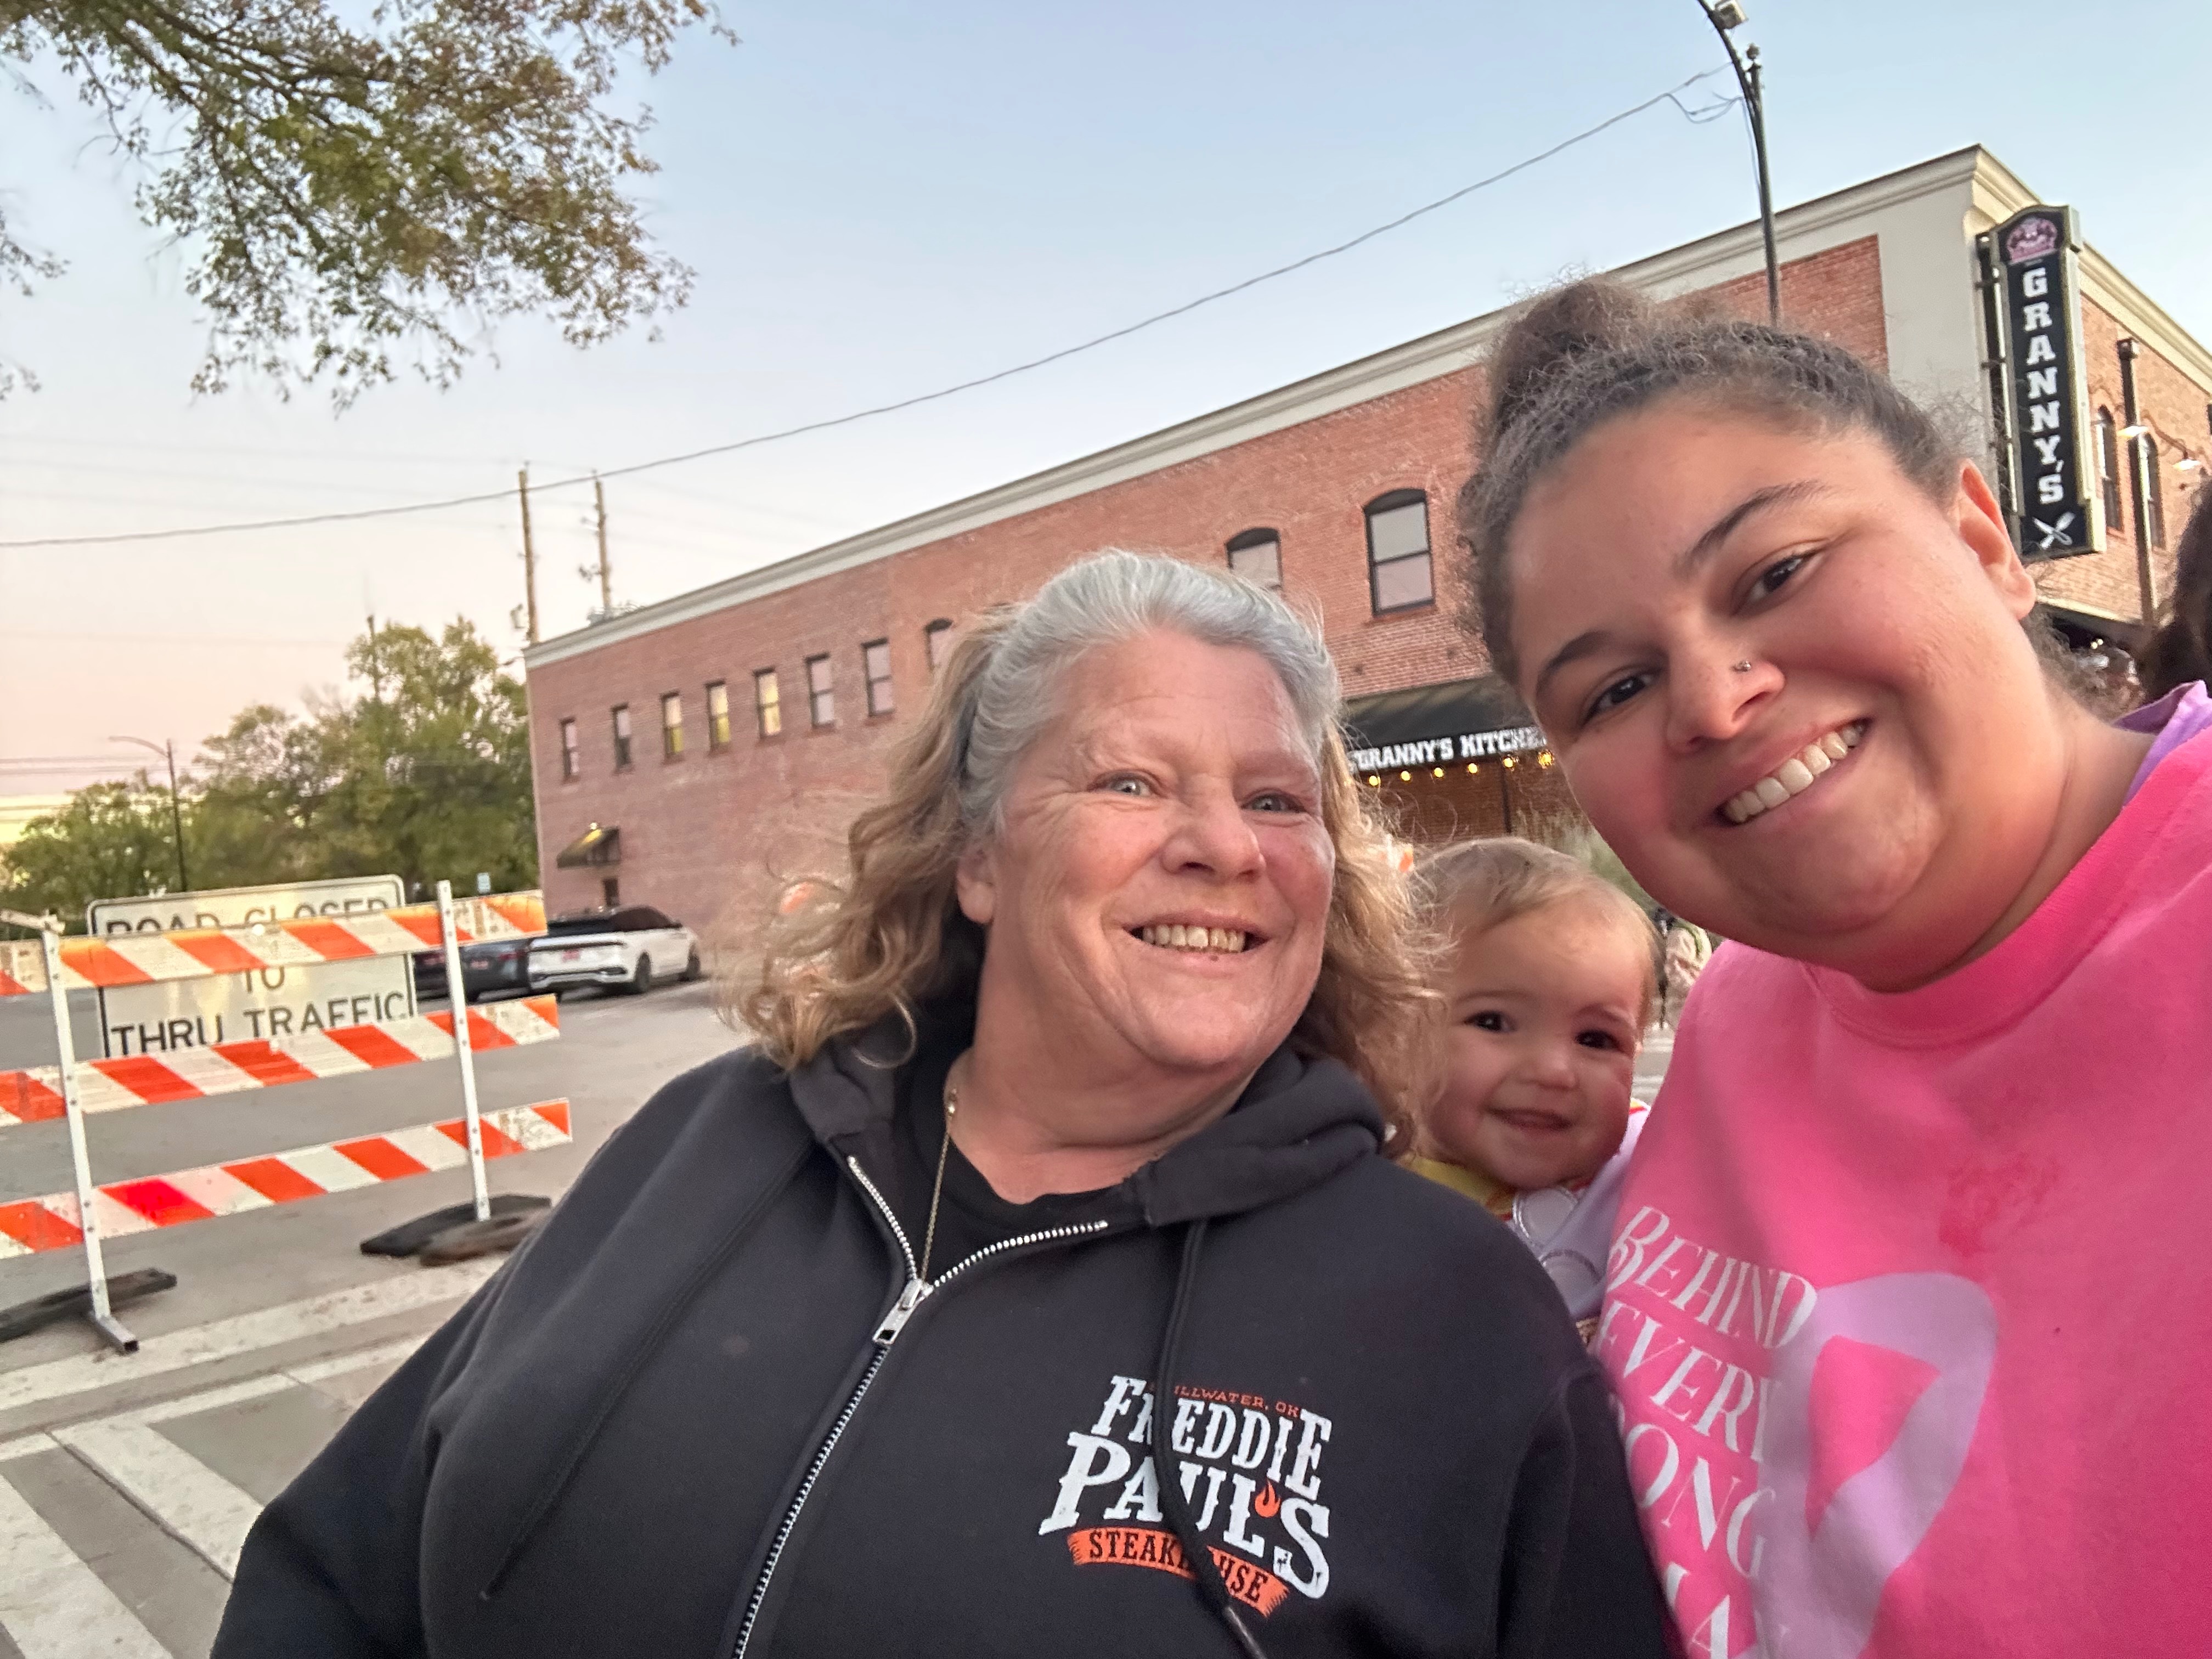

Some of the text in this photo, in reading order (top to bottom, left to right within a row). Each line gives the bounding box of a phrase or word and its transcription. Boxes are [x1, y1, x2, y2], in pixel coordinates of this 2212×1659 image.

[2022, 267, 2064, 505] GRANNY'S
[1459, 726, 1547, 758] KITCHE
[111, 1013, 223, 1056] THRU
[243, 991, 404, 1037] TRAFFIC
[1607, 1206, 1818, 1350] BEHIND
[1173, 1384, 1267, 1410] ILLWATER,
[1088, 1528, 1268, 1603] STEAKUSE
